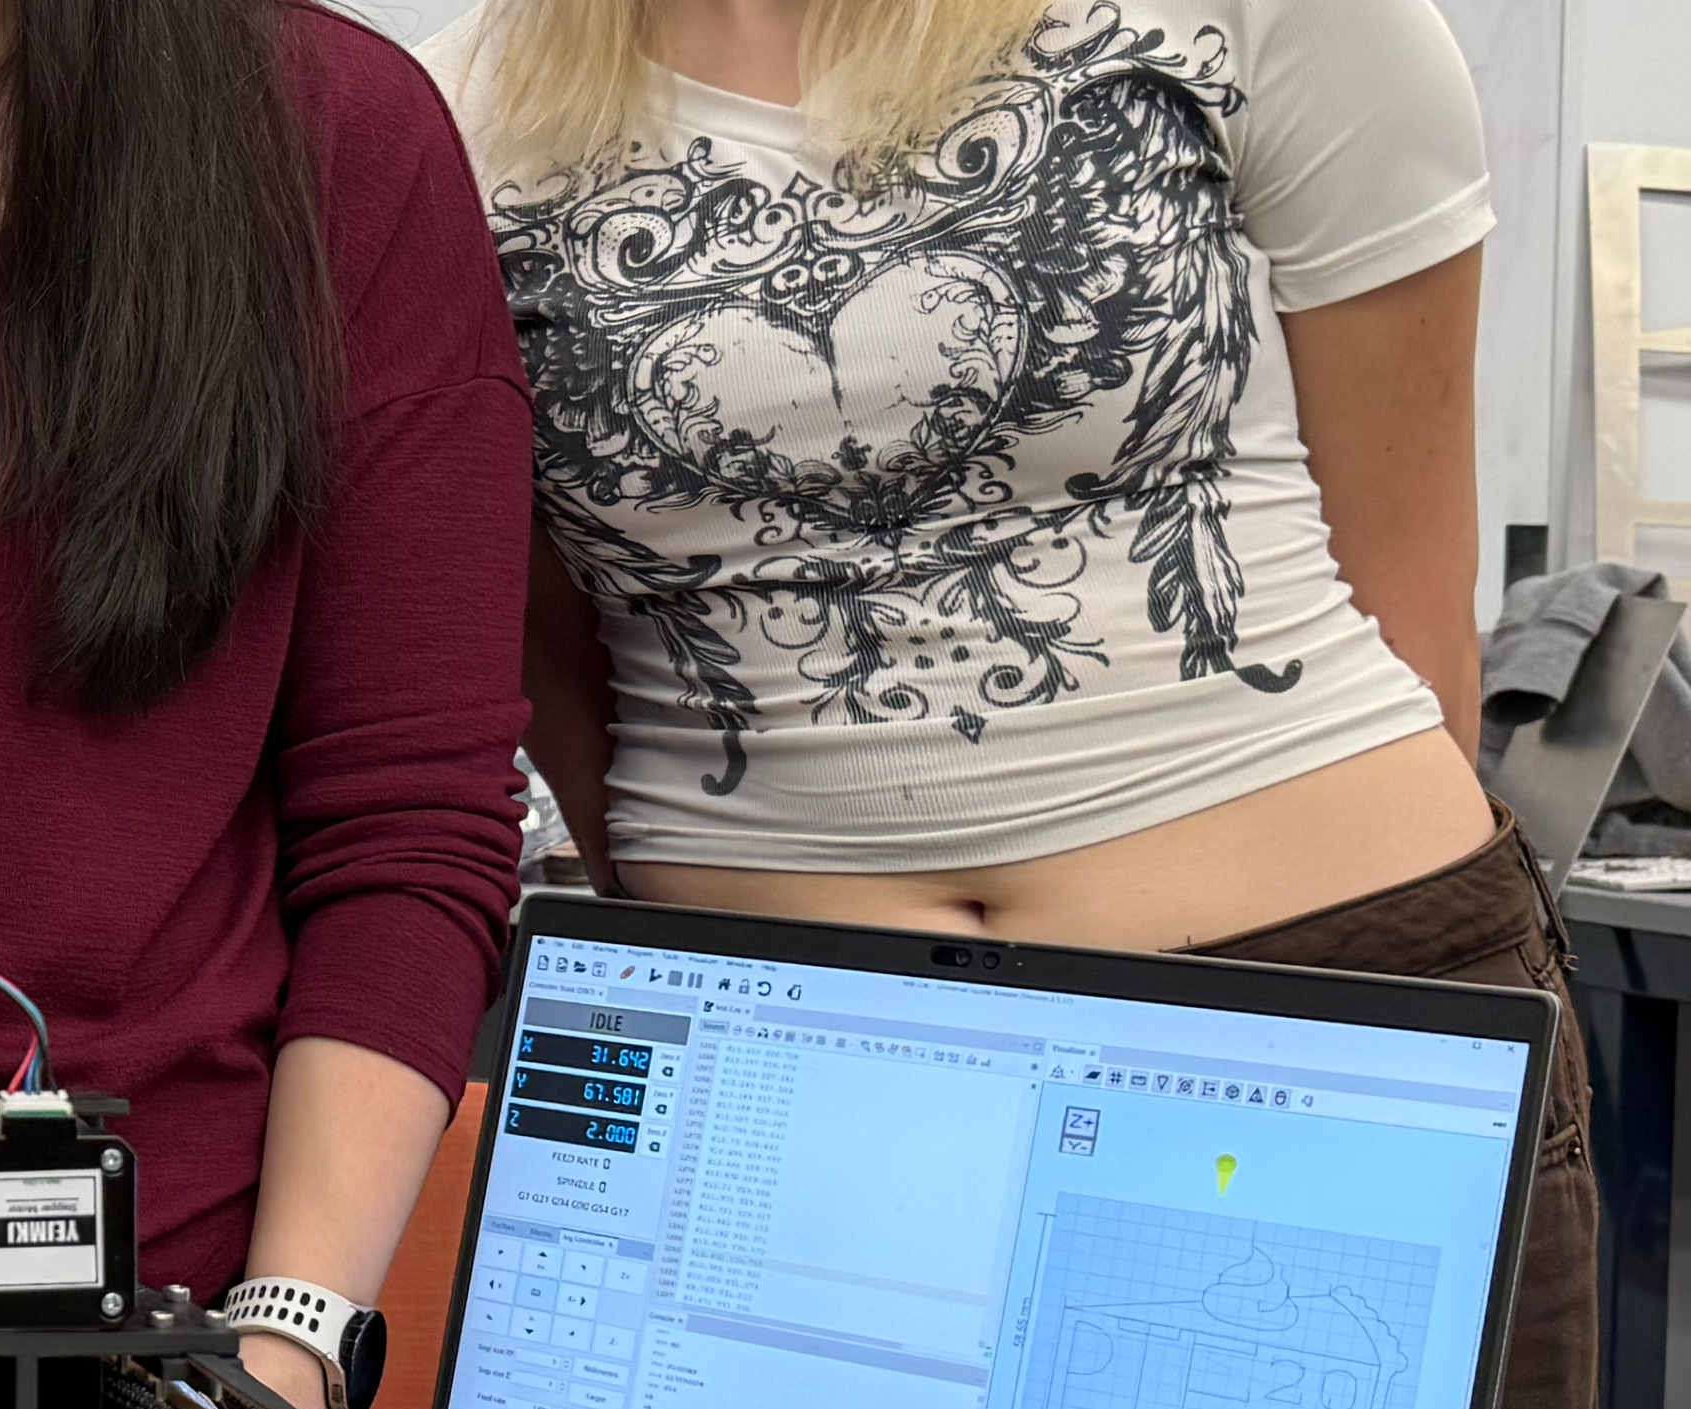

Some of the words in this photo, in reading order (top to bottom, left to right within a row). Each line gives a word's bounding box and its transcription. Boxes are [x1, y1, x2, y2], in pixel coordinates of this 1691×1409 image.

[589, 1012, 623, 1032] IDLE
[521, 1035, 534, 1053] X
[591, 1044, 650, 1070] 31.642
[516, 1072, 527, 1088] Y
[583, 1082, 641, 1106] 67.581
[509, 1109, 521, 1128] Z
[585, 1121, 637, 1145] 2.000
[1068, 1113, 1095, 1130] Z+
[1068, 1139, 1088, 1151] Y-
